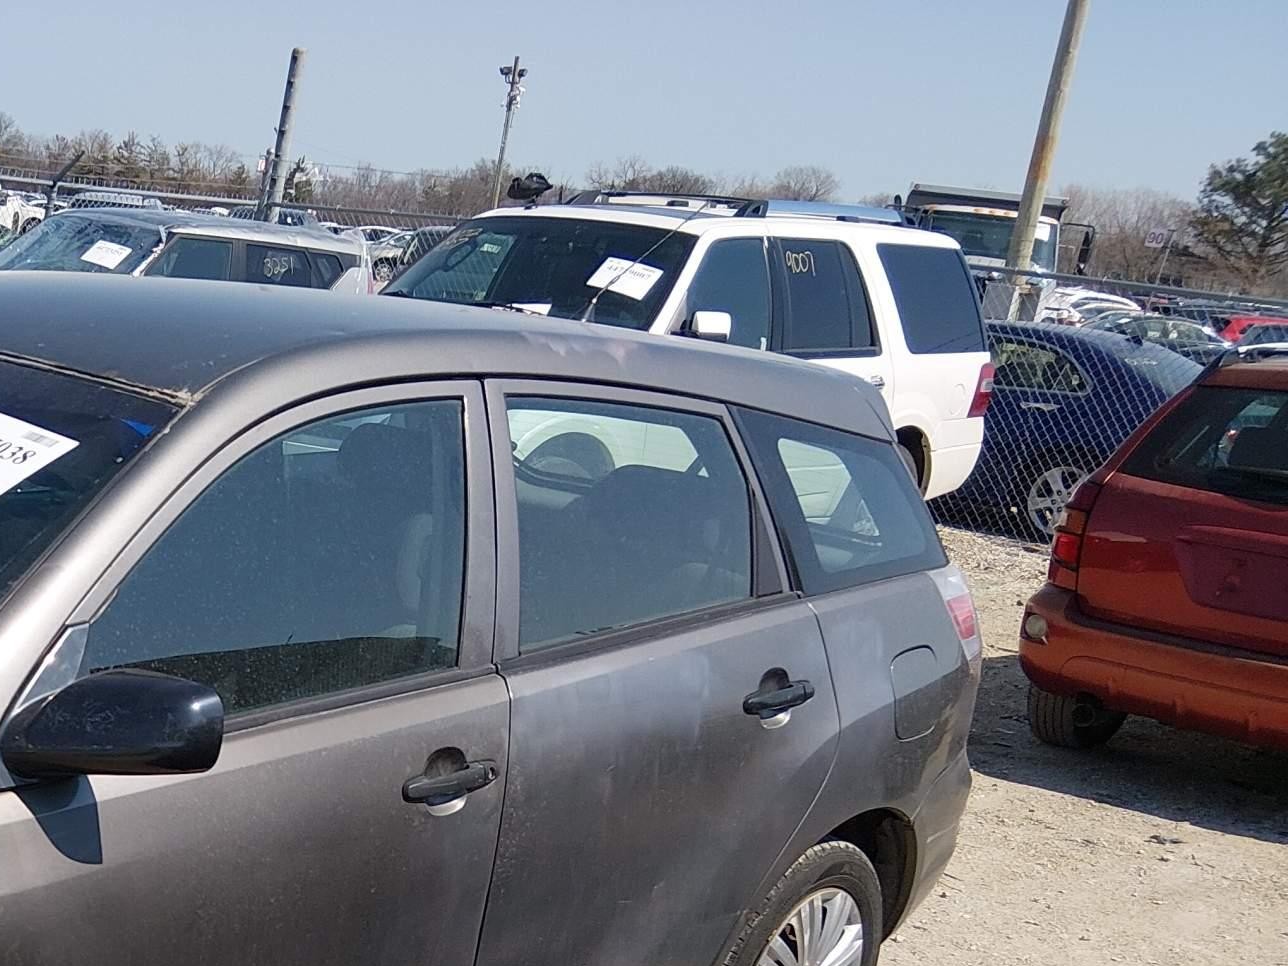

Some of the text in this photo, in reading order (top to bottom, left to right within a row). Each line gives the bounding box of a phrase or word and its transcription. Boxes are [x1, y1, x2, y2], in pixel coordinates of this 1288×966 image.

[1147, 231, 1164, 244] 90
[263, 256, 295, 277] 3251
[785, 250, 817, 277] 9007
